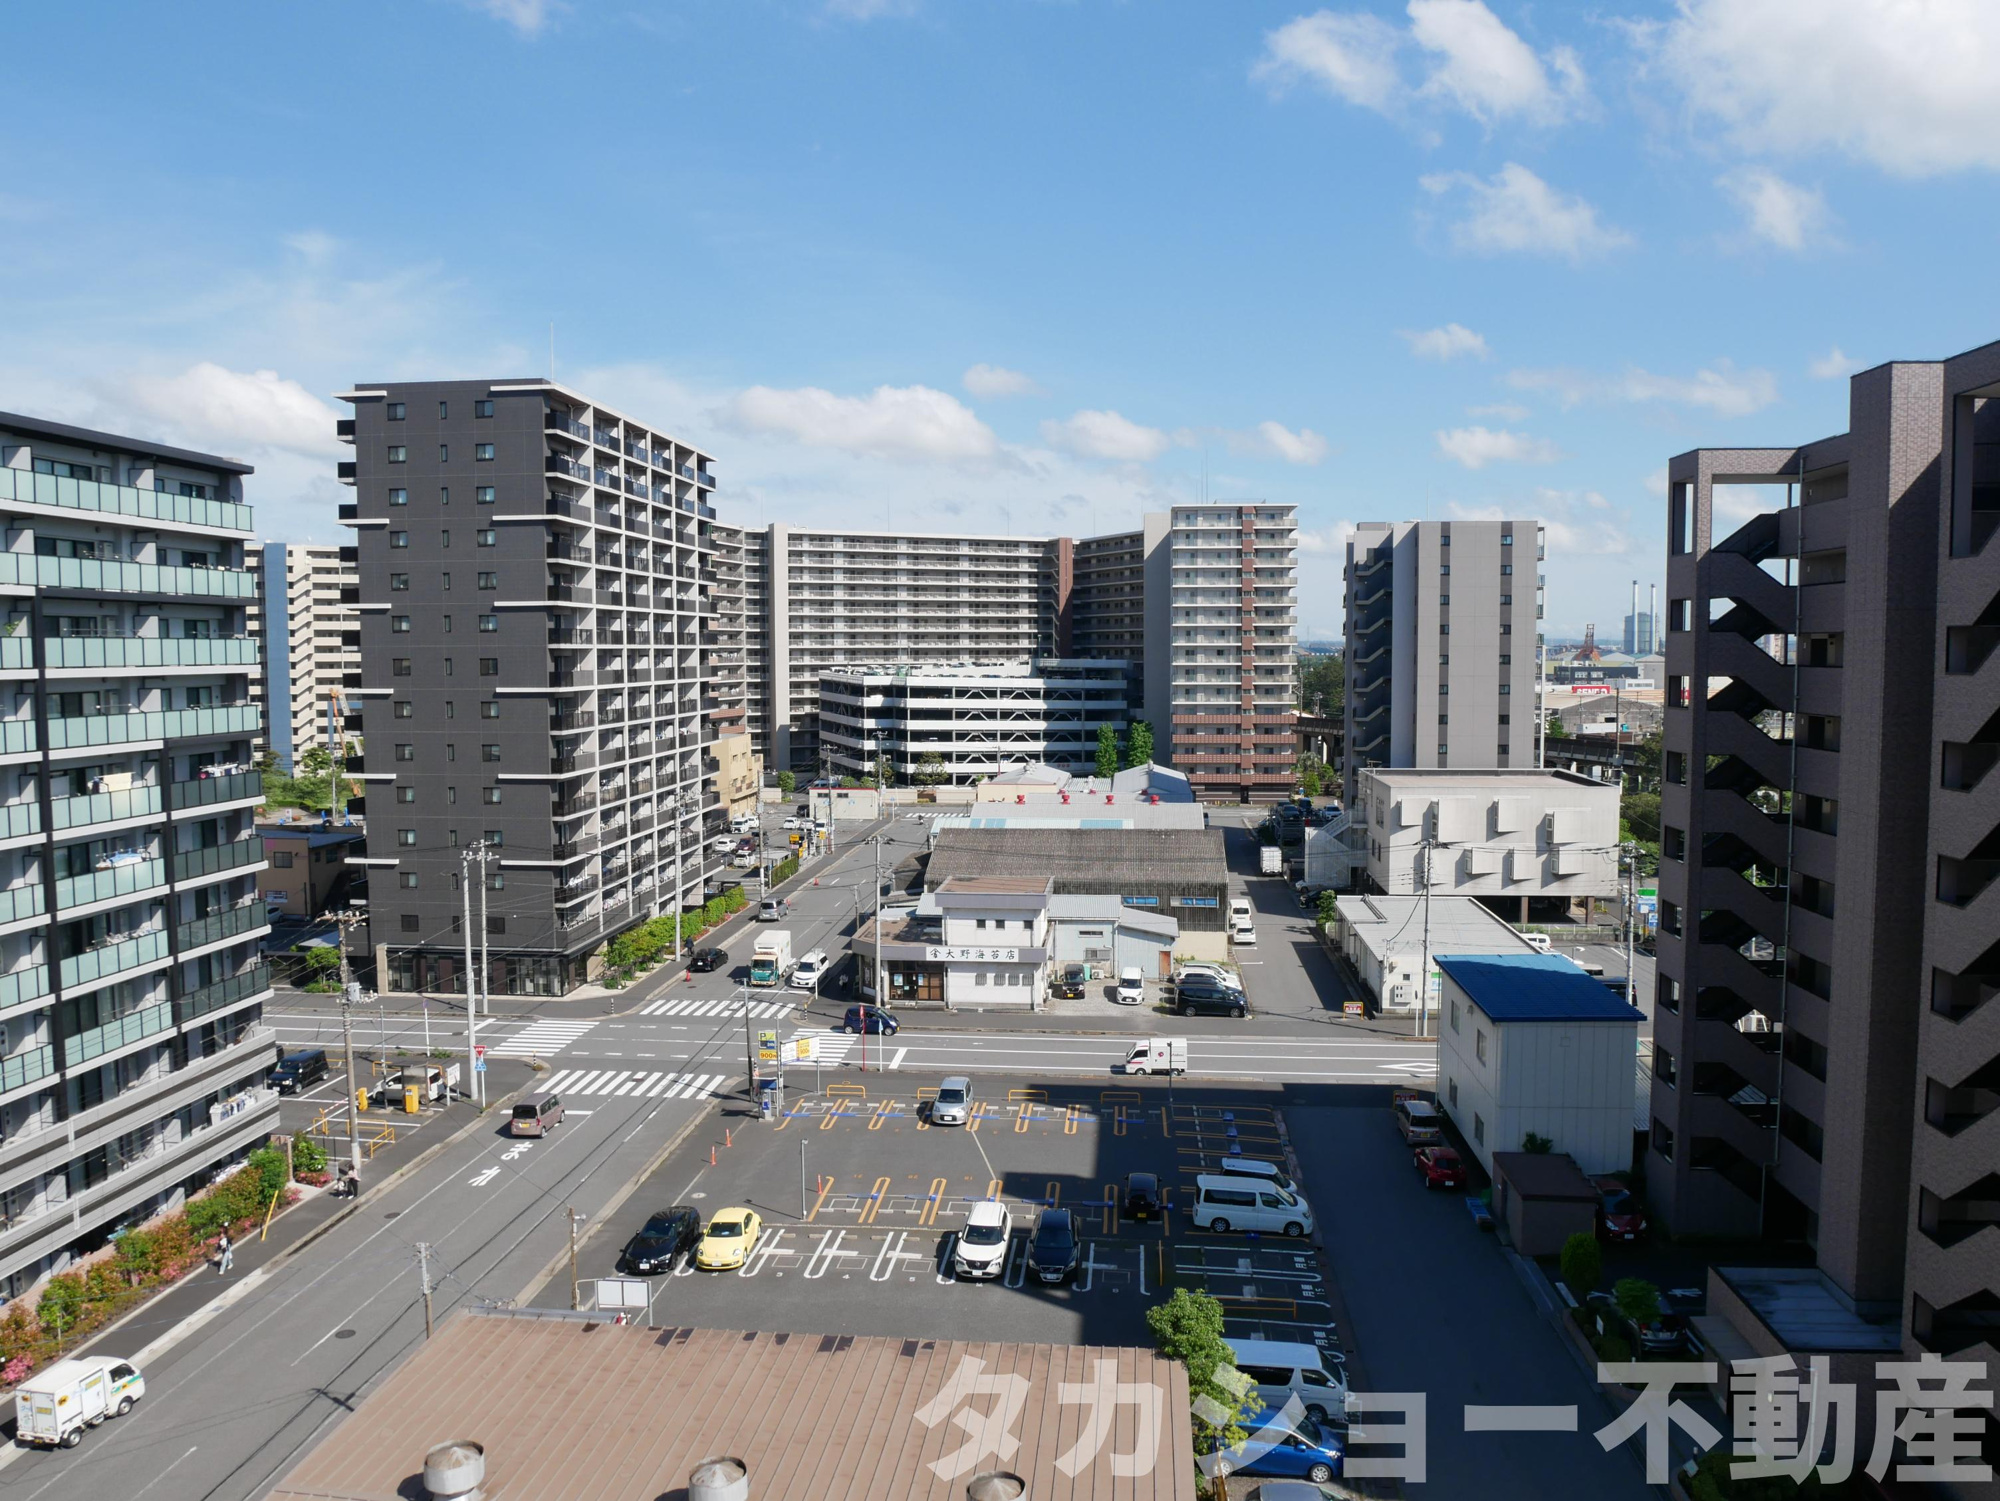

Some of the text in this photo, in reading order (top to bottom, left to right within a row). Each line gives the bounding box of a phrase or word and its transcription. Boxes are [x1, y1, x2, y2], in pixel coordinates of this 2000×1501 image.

[945, 949, 1016, 960] 大野海苔店
